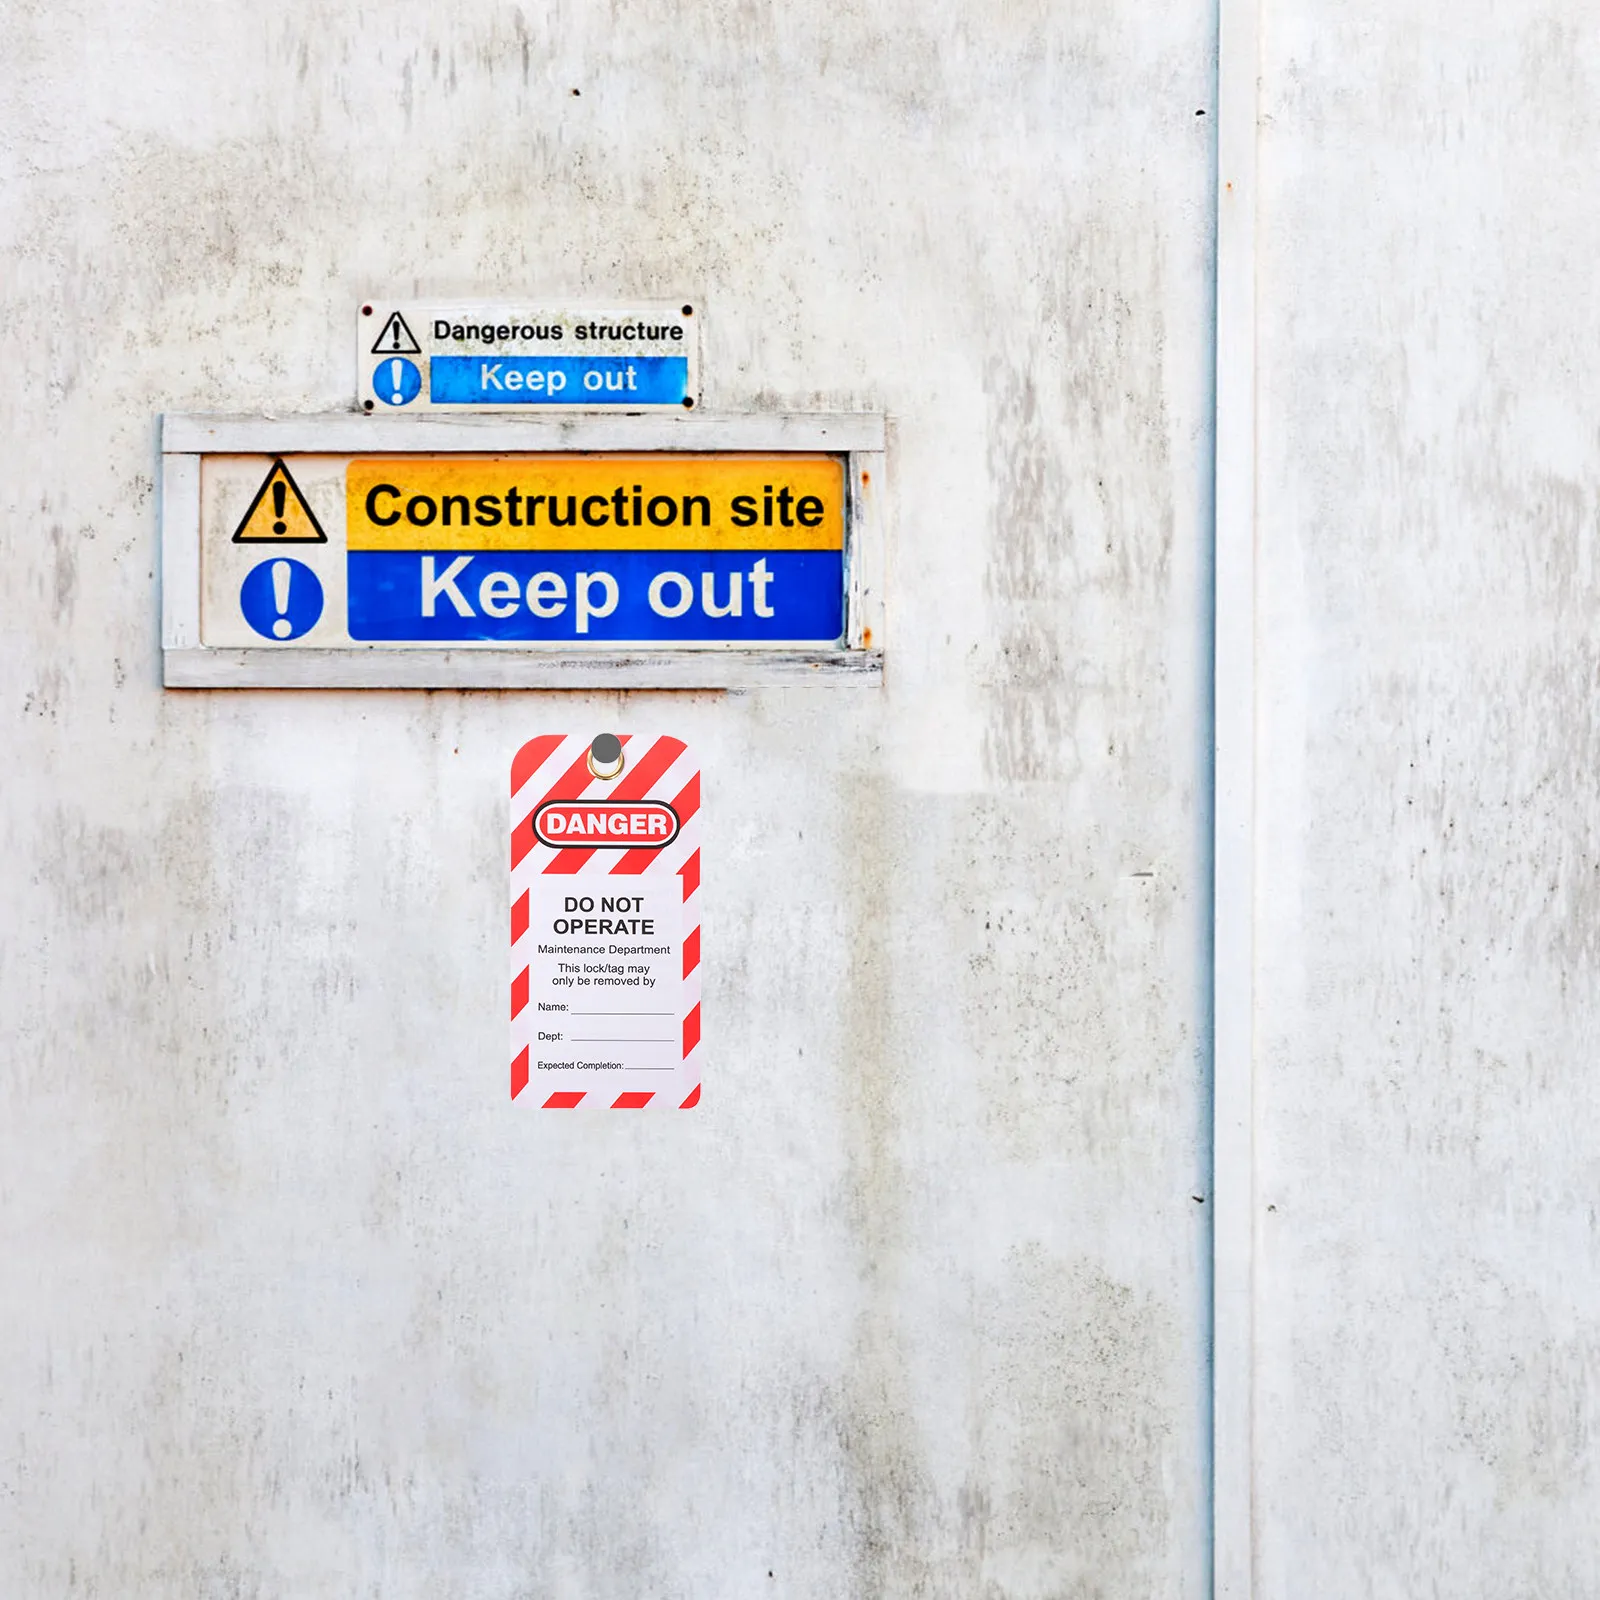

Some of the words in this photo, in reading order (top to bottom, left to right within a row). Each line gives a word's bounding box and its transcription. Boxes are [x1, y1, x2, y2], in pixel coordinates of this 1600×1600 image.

[434, 320, 563, 343] Dangerous
[575, 321, 684, 341] structure
[481, 364, 567, 396] Keep
[584, 366, 637, 391] out
[365, 482, 711, 527] Construction
[730, 485, 825, 528] site
[420, 555, 620, 633] Keep
[648, 558, 774, 618] out
[546, 813, 667, 835] DANGER
[564, 896, 595, 913] DO
[601, 896, 644, 913] NOT
[553, 919, 655, 935] OPERATE
[537, 944, 606, 955] Maintenance
[608, 944, 671, 956] Department
[558, 963, 581, 973] This
[583, 963, 624, 976] lock/tag
[627, 965, 651, 975] may
[552, 976, 574, 987] only
[577, 976, 591, 986] be
[593, 976, 640, 986] removed
[643, 976, 656, 987] by
[537, 1002, 569, 1012] Name:
[537, 1031, 564, 1042] Dept:
[537, 1061, 575, 1070] Expected
[576, 1061, 624, 1070] Completion:
